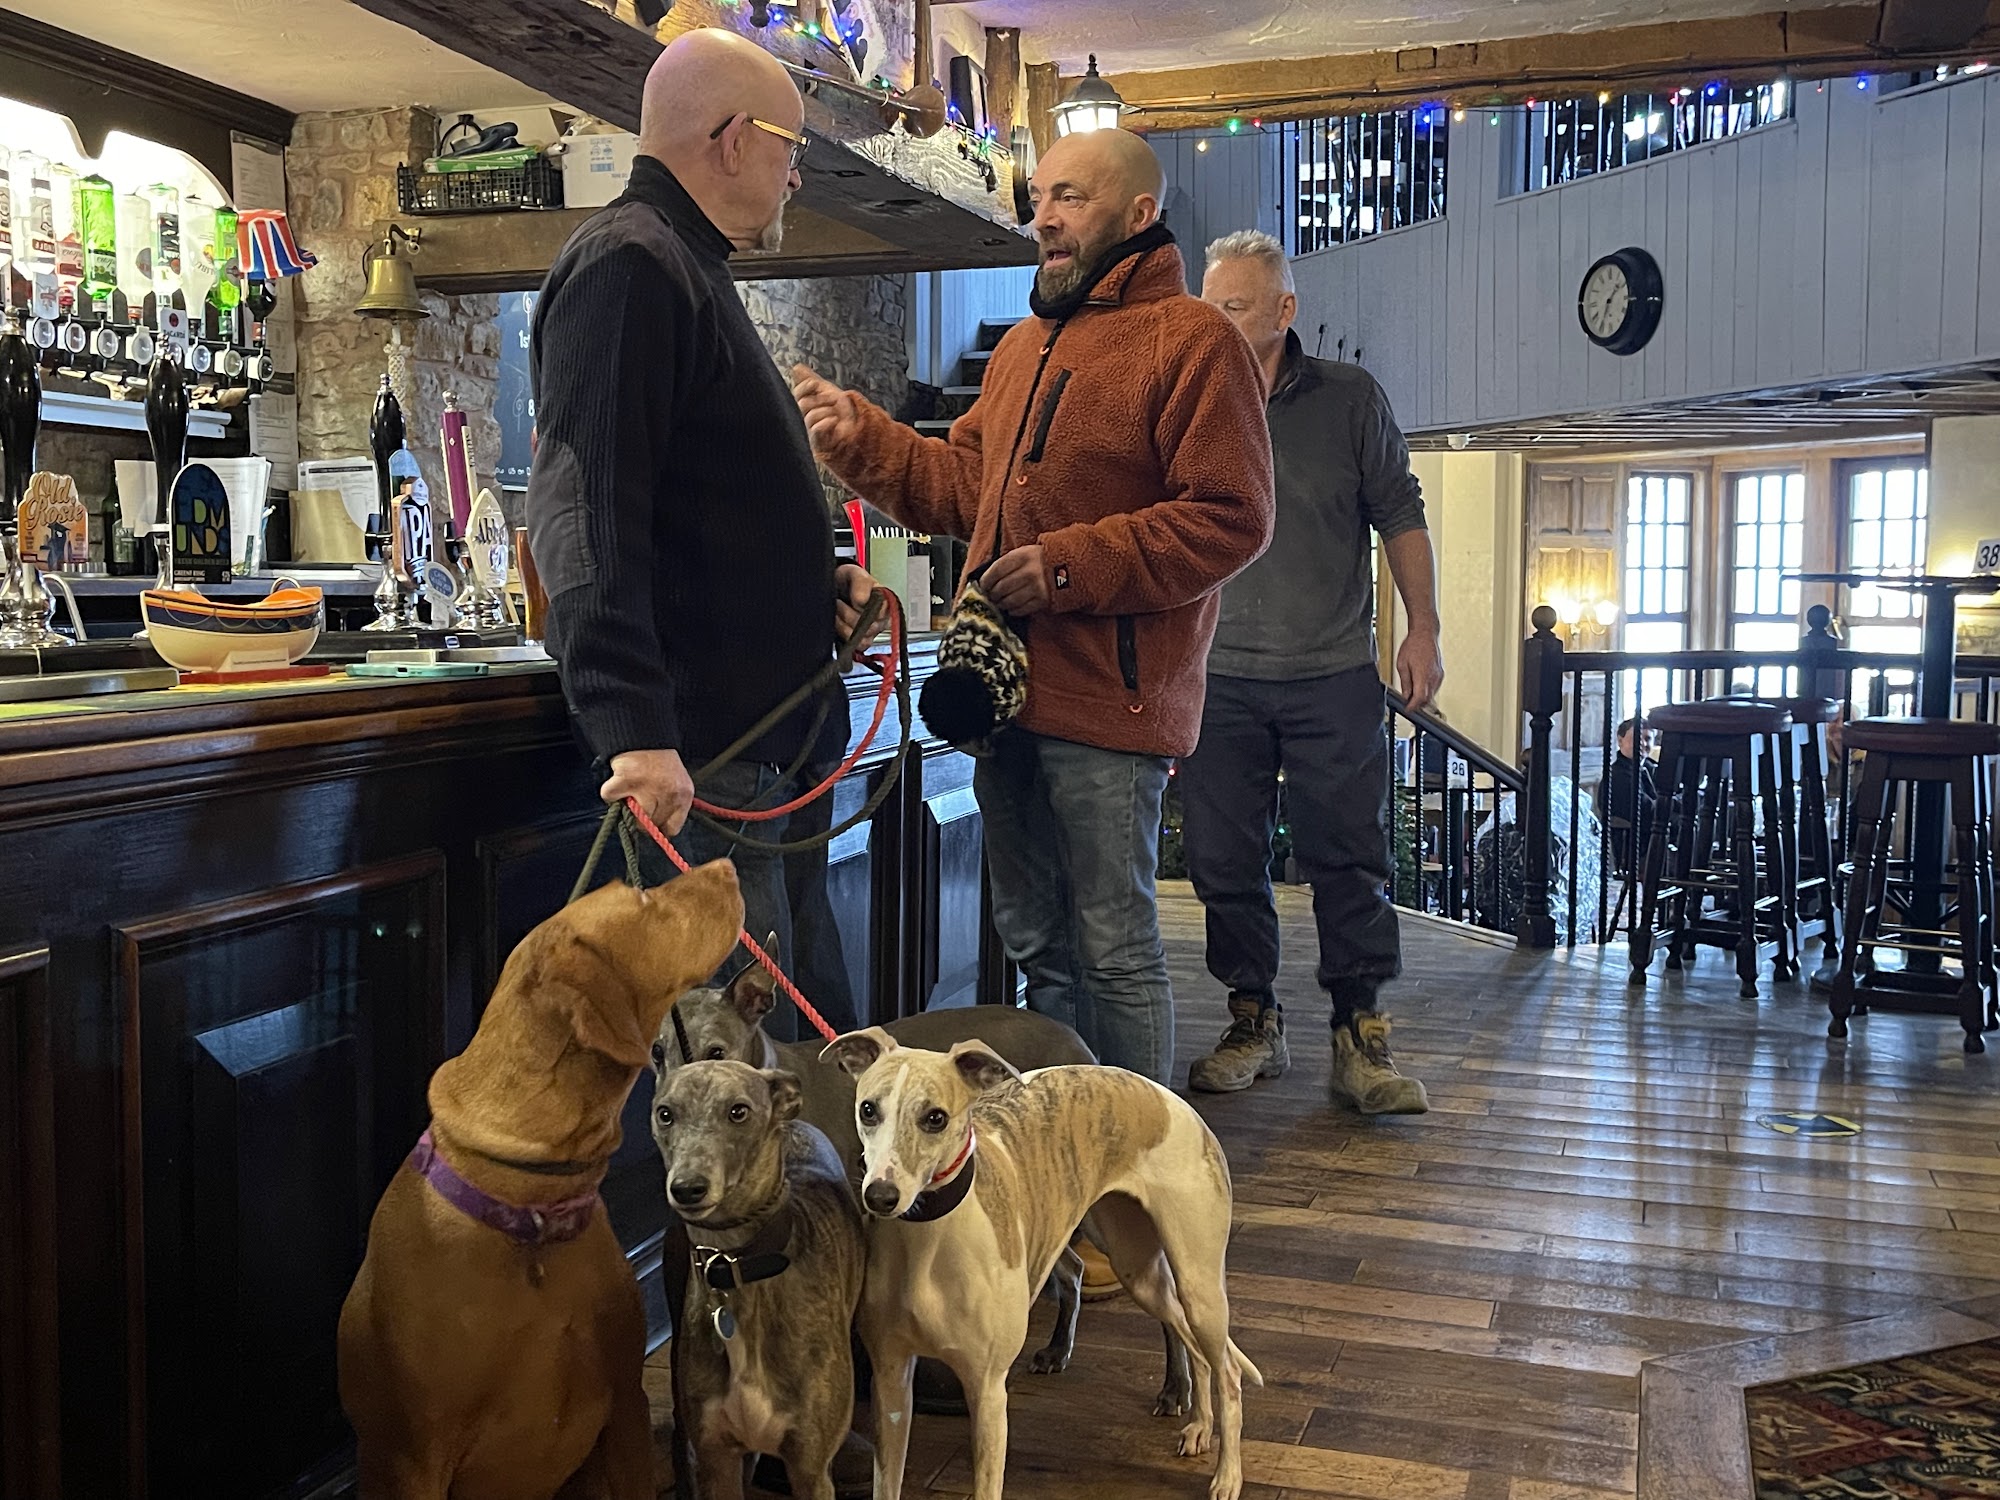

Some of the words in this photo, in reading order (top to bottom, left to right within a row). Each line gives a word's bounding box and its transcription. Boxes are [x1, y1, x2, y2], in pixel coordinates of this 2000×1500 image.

[33, 472, 72, 504] Old
[25, 497, 83, 530] Rosie
[1978, 544, 2000, 569] 38
[1452, 761, 1465, 776] 26
